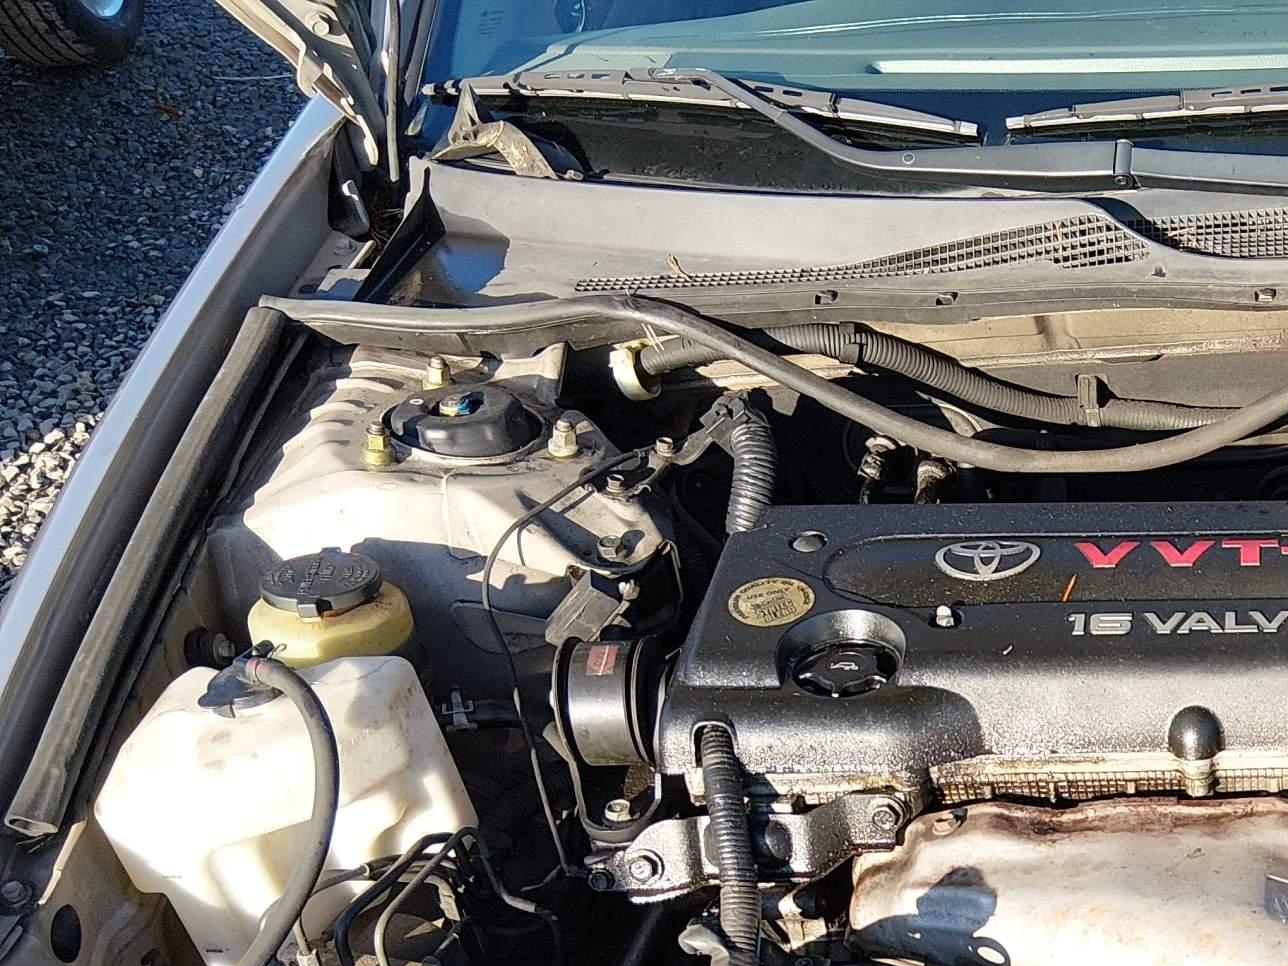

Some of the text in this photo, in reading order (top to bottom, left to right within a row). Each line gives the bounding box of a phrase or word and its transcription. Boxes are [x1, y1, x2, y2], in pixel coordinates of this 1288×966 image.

[746, 592, 764, 600] USE
[766, 587, 790, 596] ONLY
[1068, 612, 1133, 636] 16
